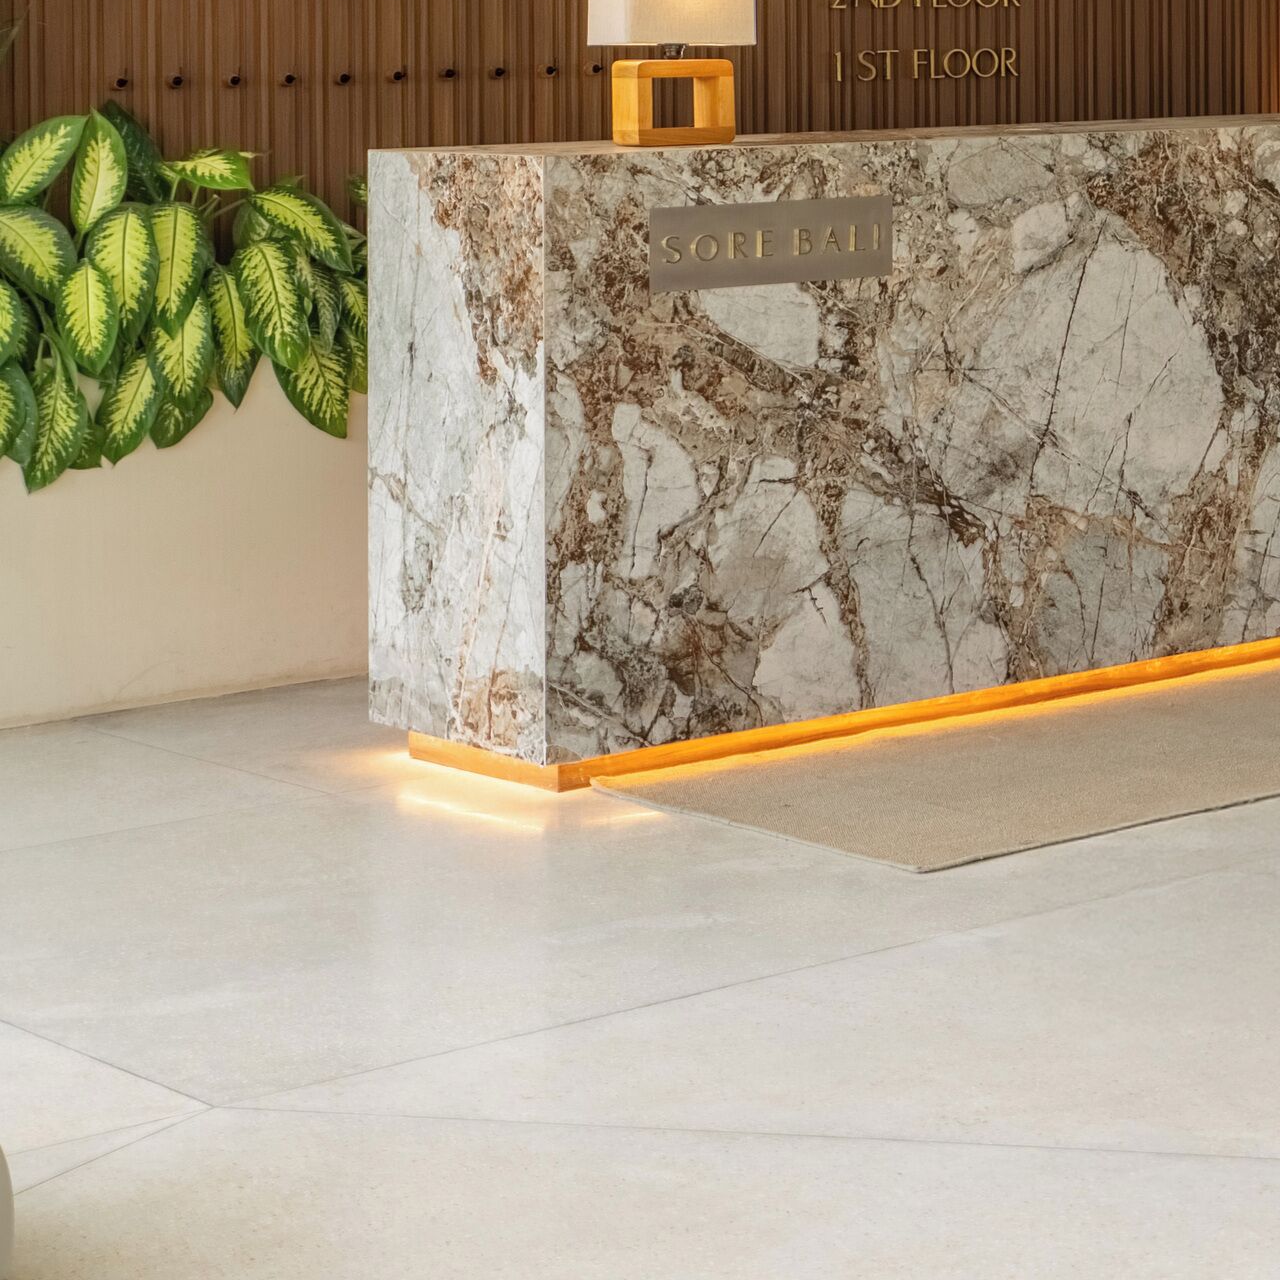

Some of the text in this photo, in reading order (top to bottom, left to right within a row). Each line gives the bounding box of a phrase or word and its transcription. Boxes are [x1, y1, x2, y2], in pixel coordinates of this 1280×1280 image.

[833, 47, 1019, 82] 1ST FLOOR
[661, 222, 881, 265] SORE BALI
